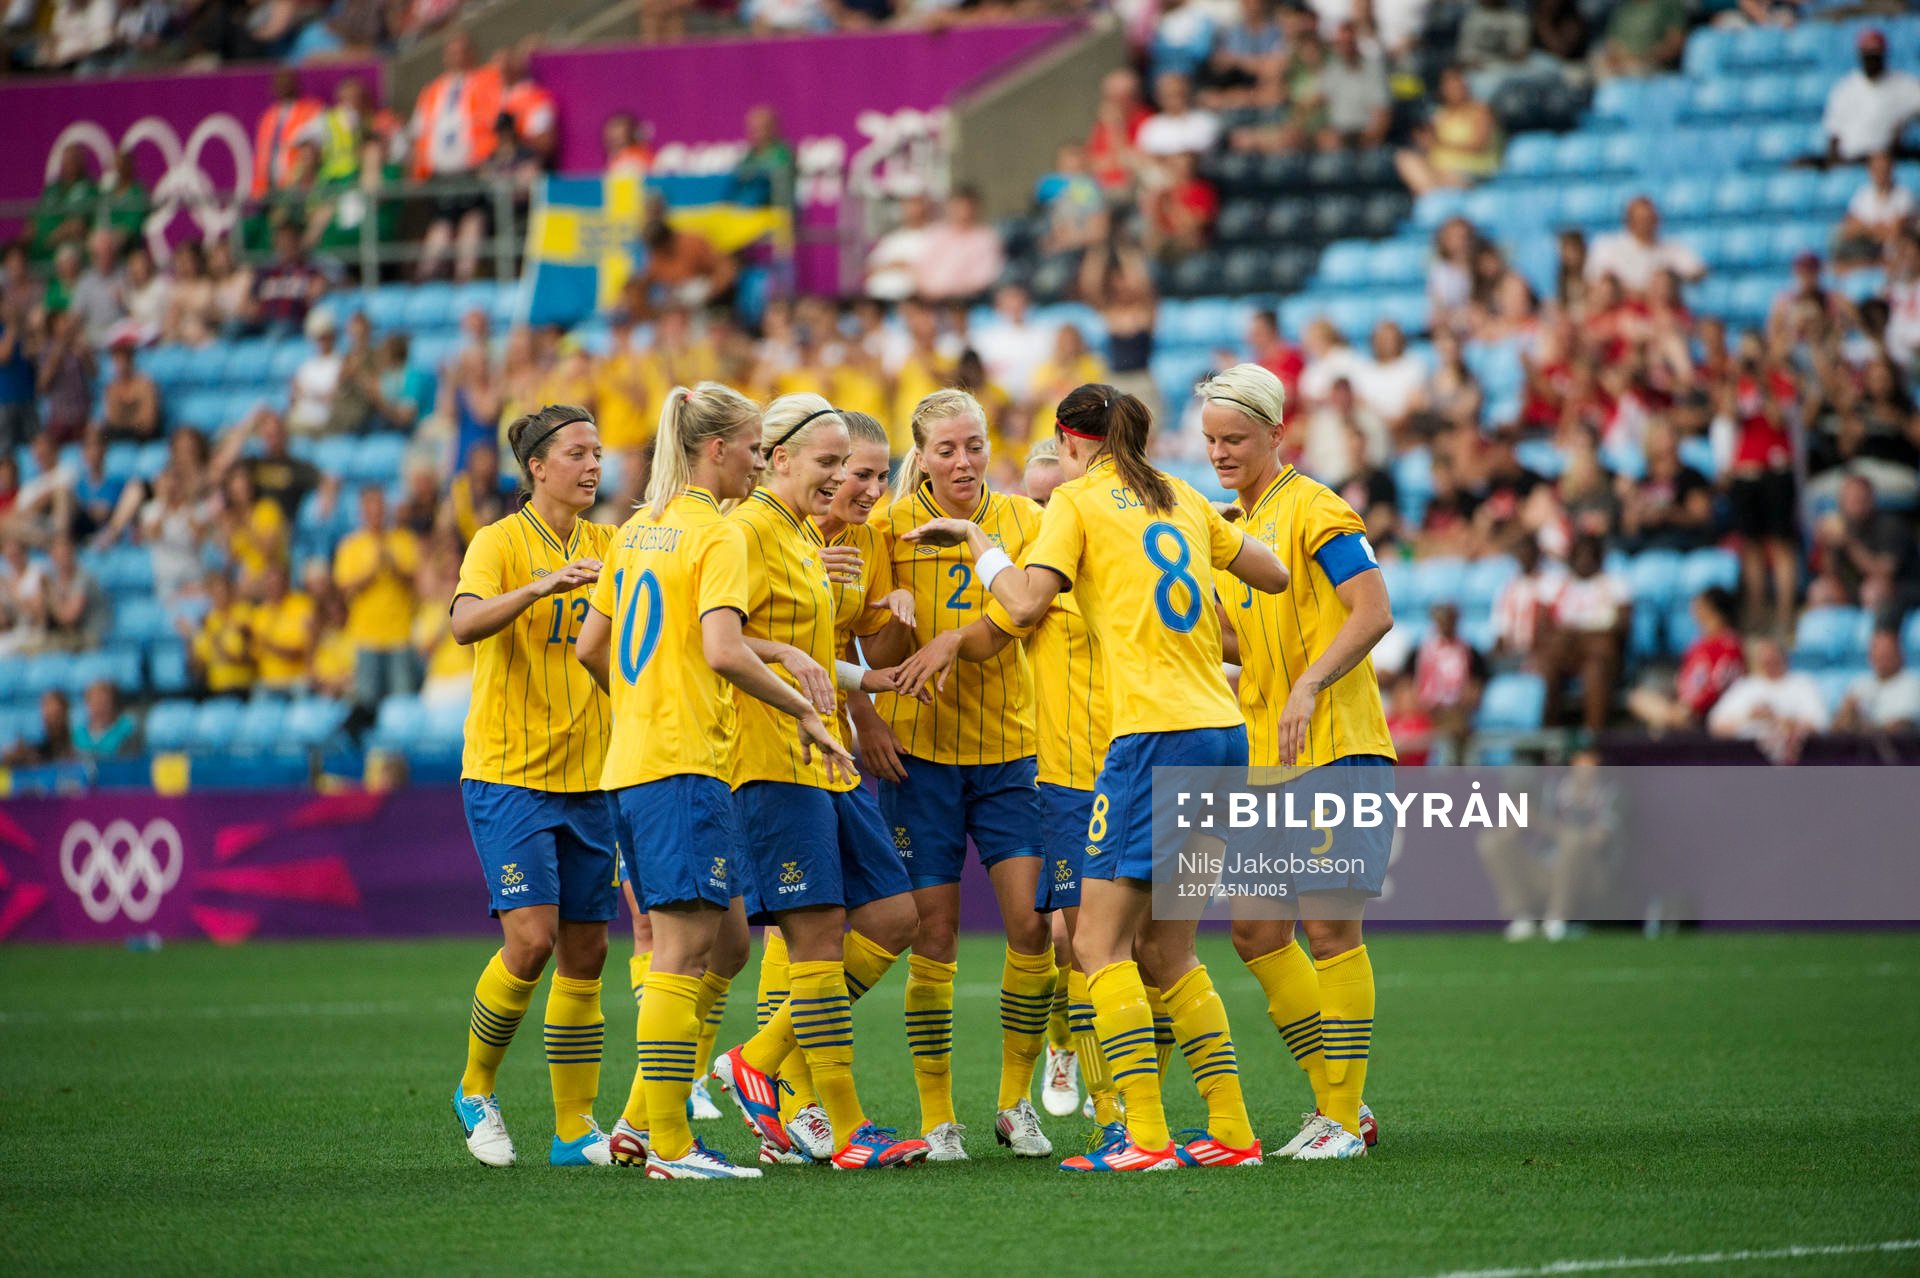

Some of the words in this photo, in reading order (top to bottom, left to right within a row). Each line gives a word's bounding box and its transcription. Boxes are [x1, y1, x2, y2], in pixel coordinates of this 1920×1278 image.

[946, 563, 972, 609] 2
[1142, 521, 1202, 634] 8
[547, 597, 590, 645] 13
[1087, 793, 1110, 842] 8
[1310, 808, 1334, 855] 5
[898, 850, 914, 858] WE
[501, 883, 530, 896] SWE
[708, 878, 727, 890] SWE
[778, 882, 807, 895] SWE
[1054, 881, 1076, 891] SWE
